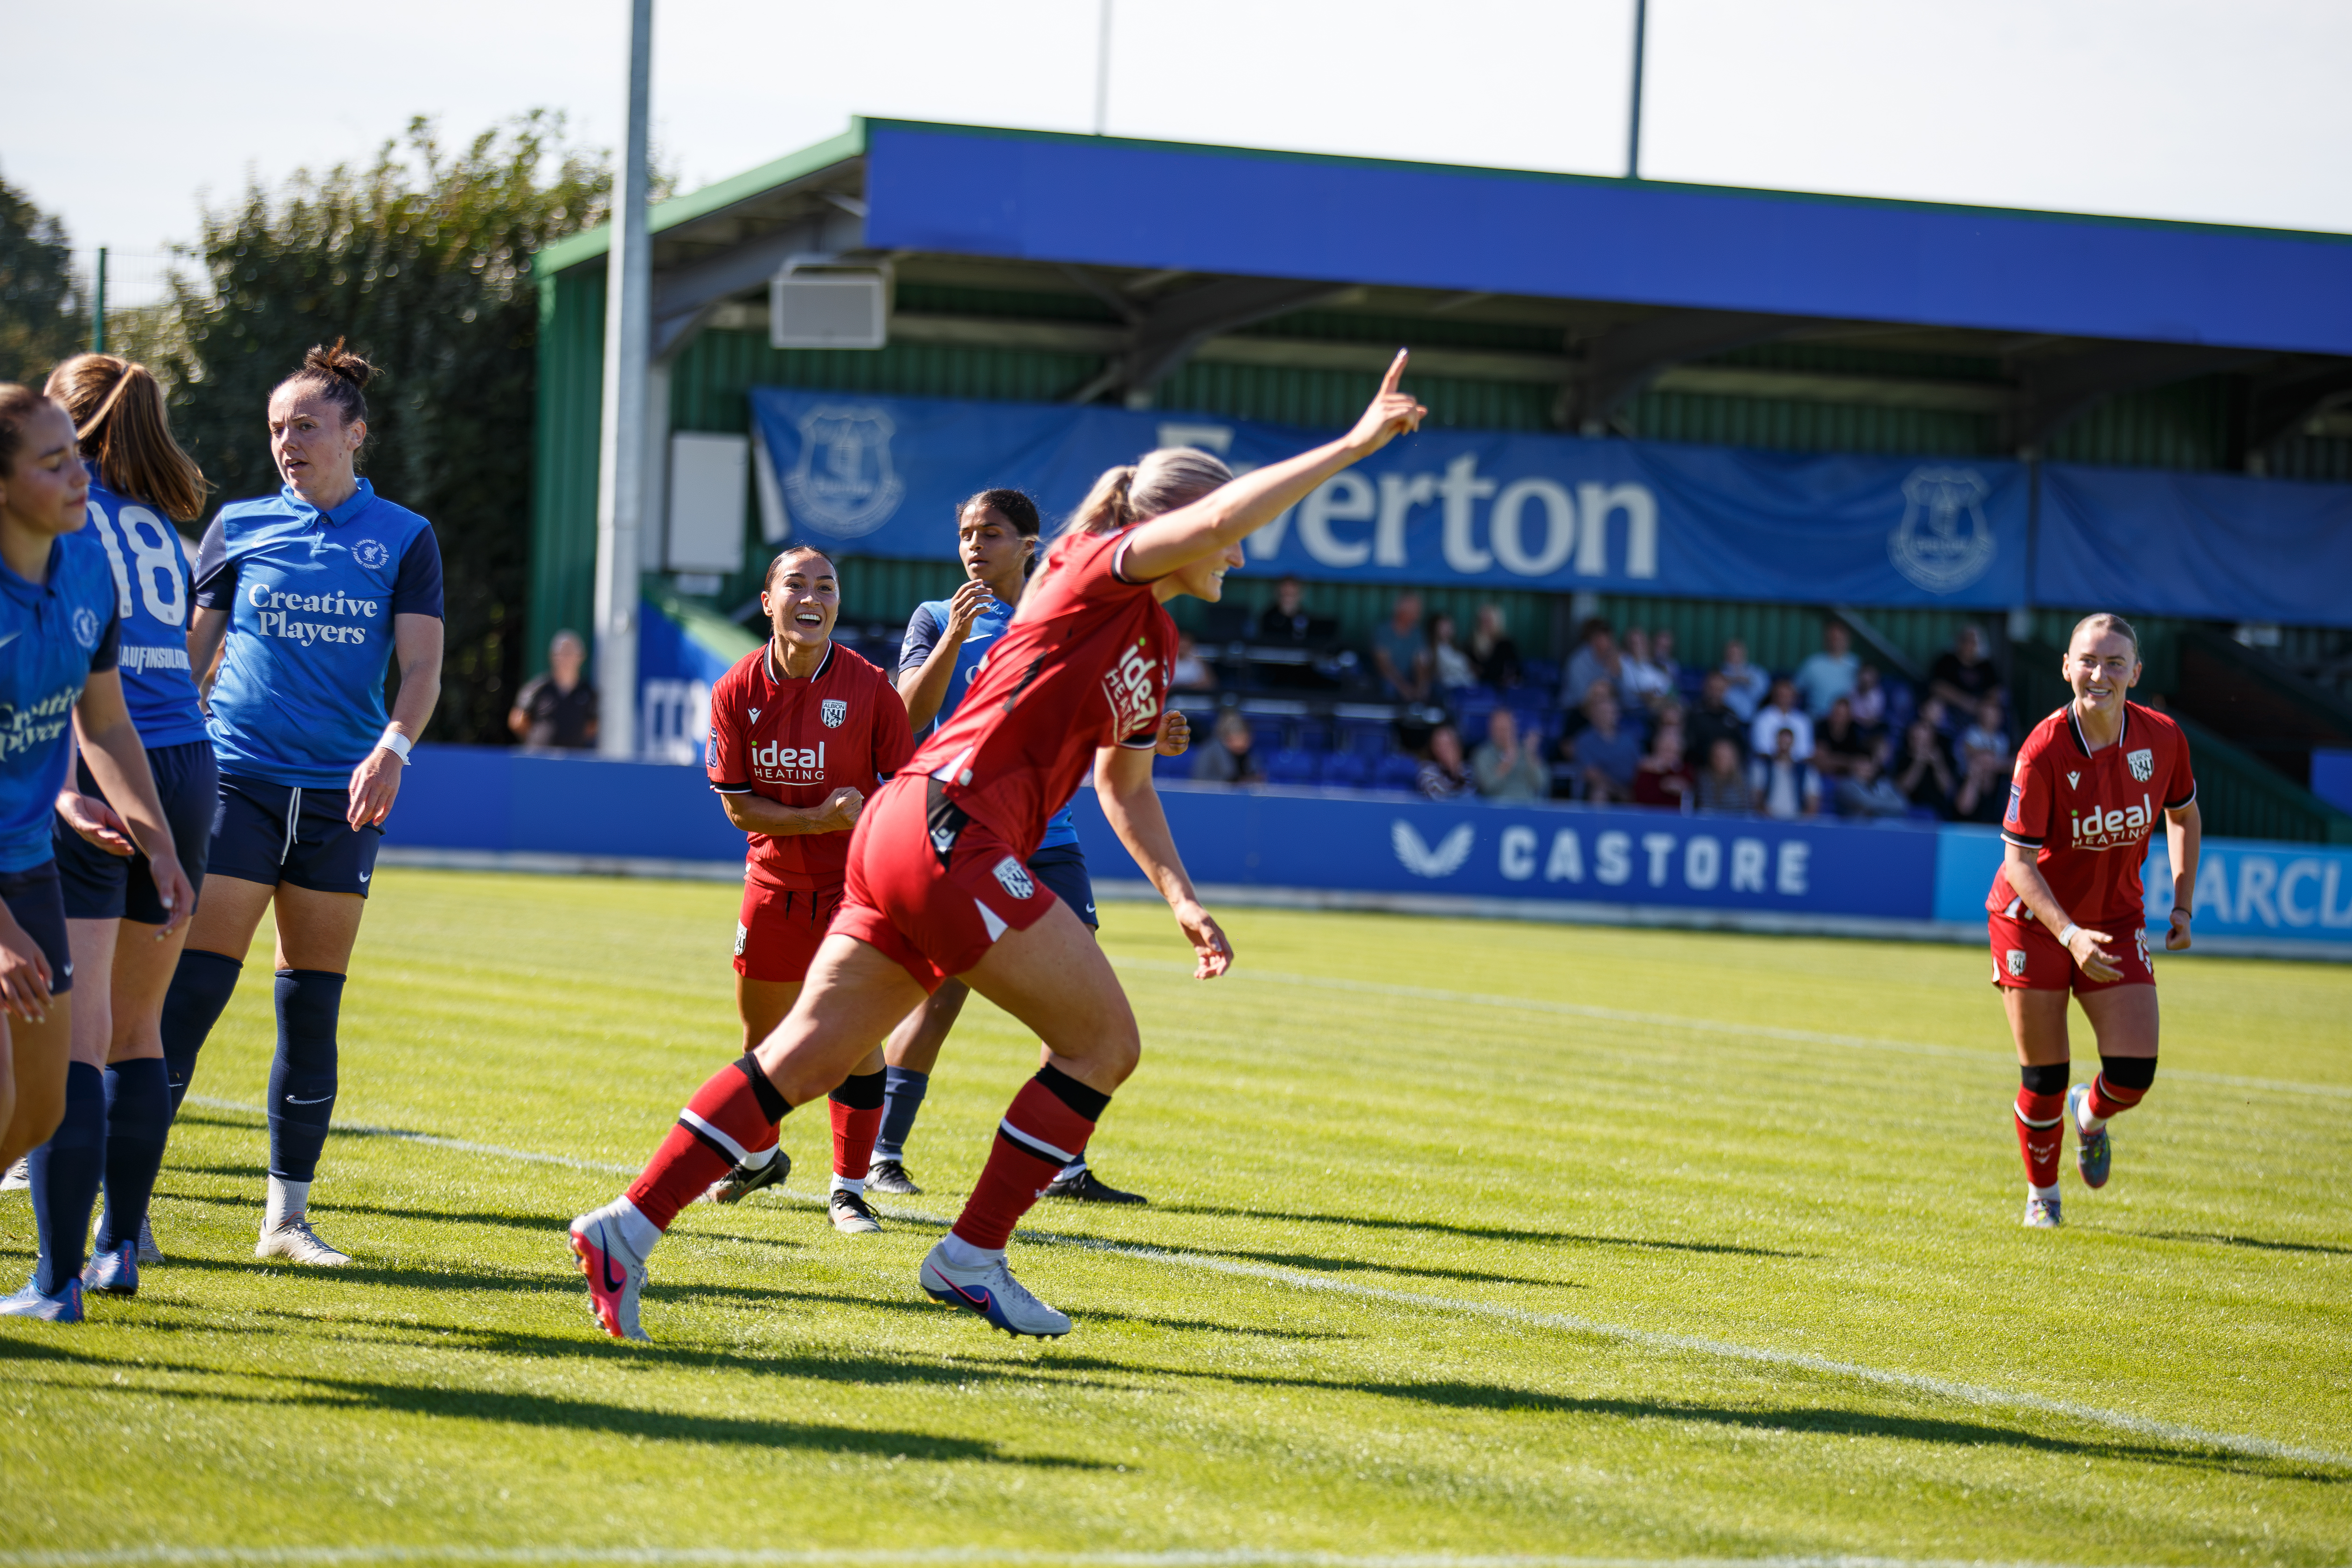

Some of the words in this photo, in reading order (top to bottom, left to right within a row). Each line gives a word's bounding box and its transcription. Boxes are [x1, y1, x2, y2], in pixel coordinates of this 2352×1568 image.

[86, 501, 187, 627] 18
[248, 584, 378, 617] Creative
[257, 611, 366, 647] Players
[1120, 636, 1158, 731] ideal
[751, 740, 825, 768] ideal
[754, 768, 824, 780] HEATING
[2071, 793, 2152, 838] ideal
[2072, 825, 2150, 848] HEATING
[1498, 824, 1811, 896] CASTORE
[2146, 855, 2352, 929] BARCL
